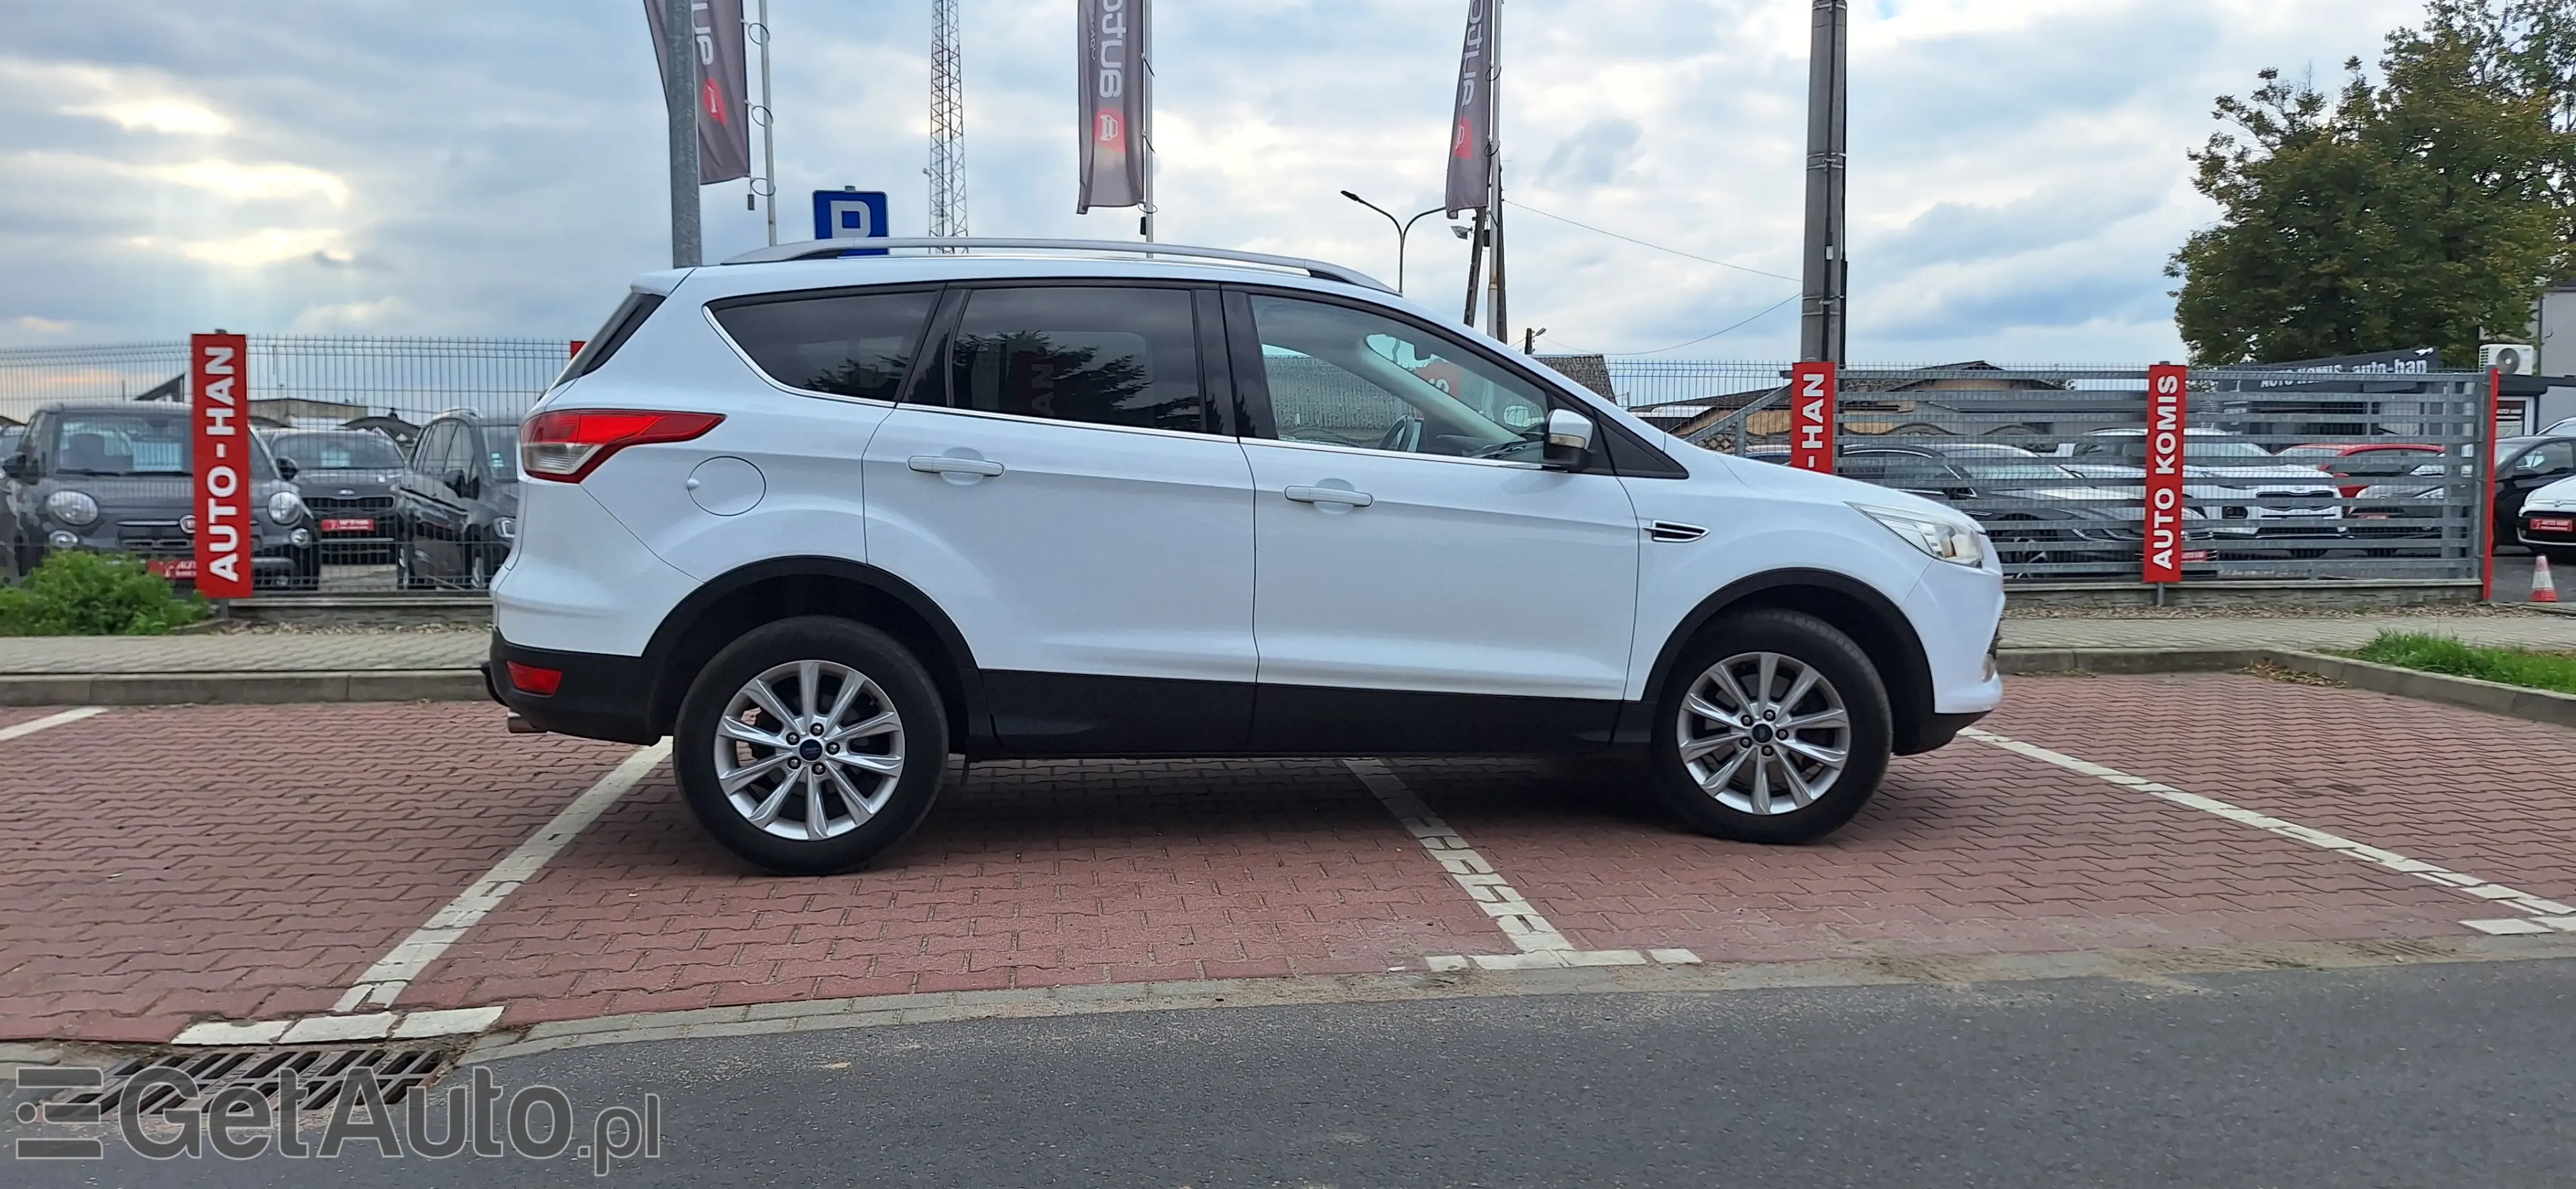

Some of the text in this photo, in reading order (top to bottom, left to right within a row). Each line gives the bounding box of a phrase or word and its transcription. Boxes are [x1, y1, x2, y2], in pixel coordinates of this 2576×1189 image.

[830, 200, 871, 239] P
[205, 346, 240, 583] AUTO-HAN
[2151, 374, 2179, 570] AUTO KOMIS
